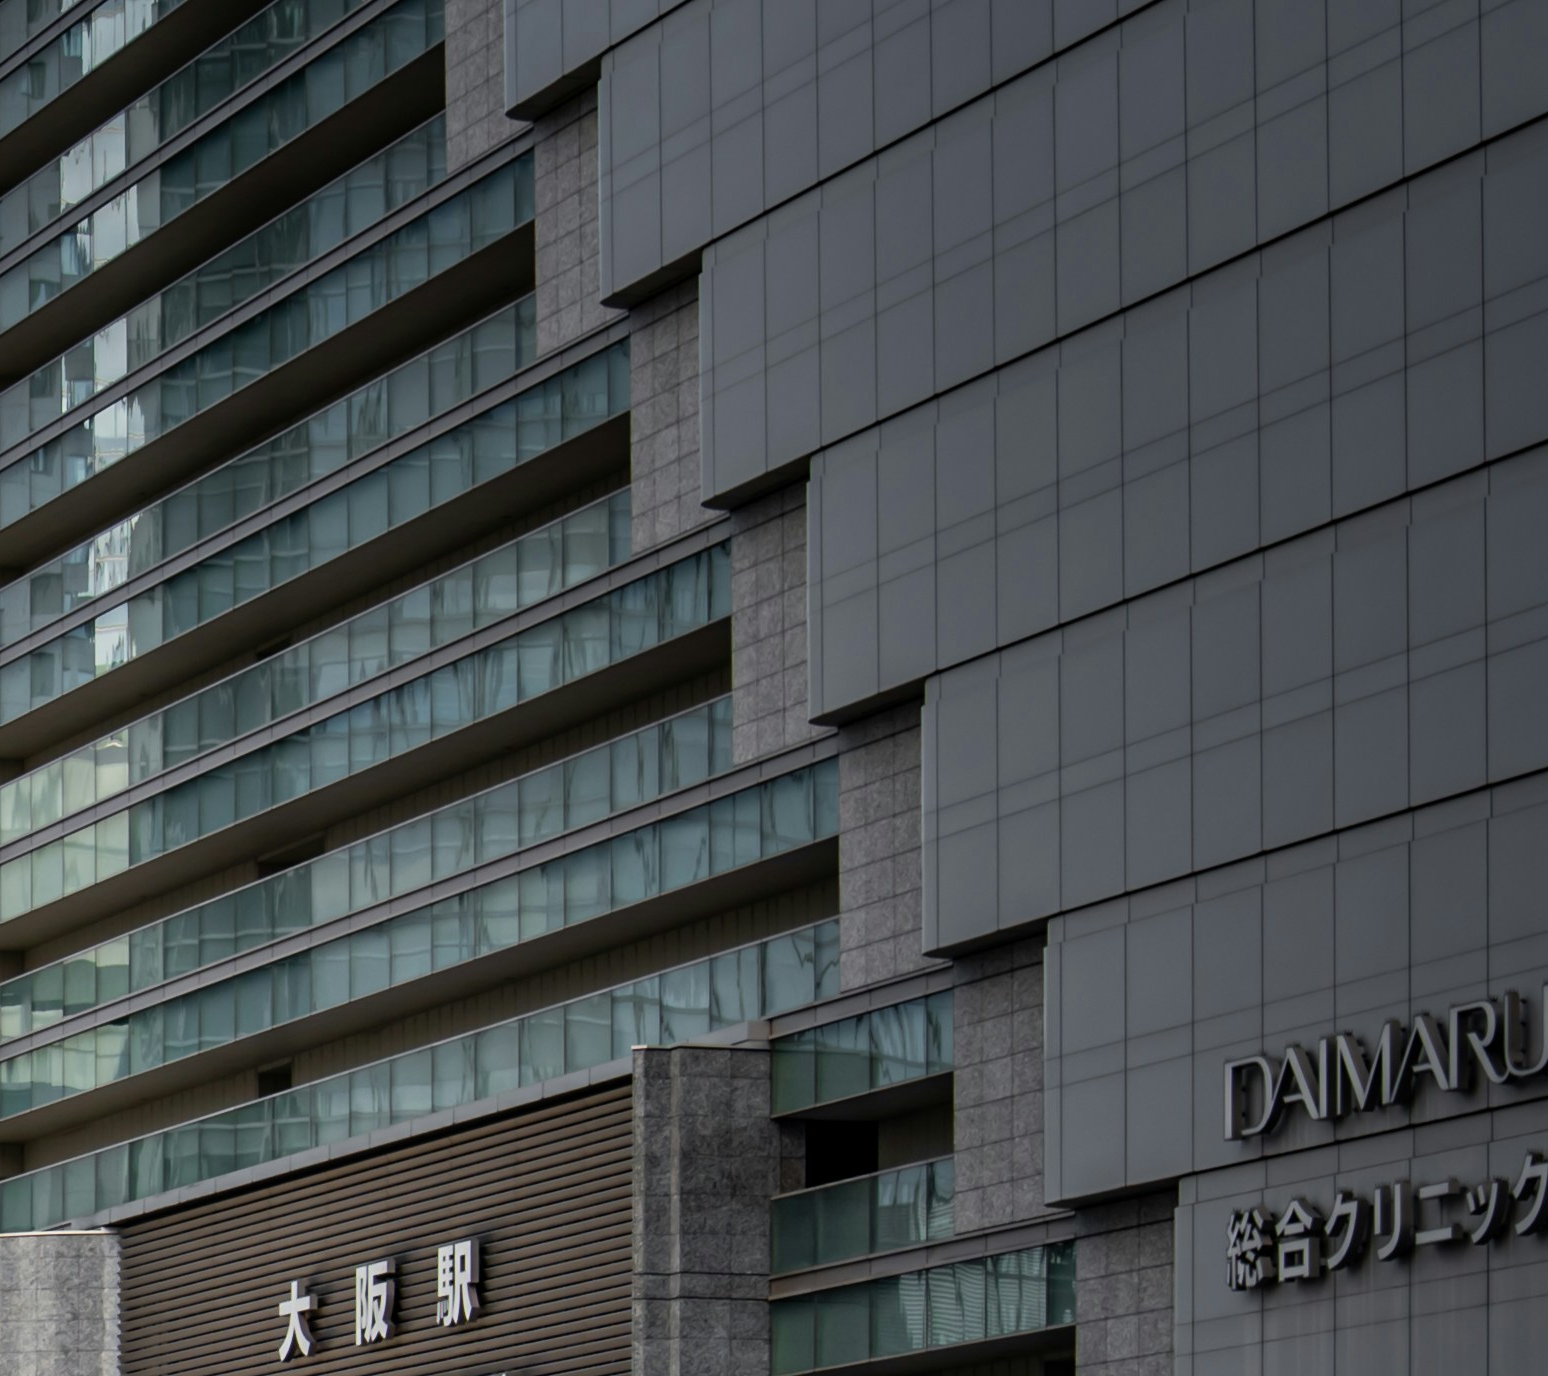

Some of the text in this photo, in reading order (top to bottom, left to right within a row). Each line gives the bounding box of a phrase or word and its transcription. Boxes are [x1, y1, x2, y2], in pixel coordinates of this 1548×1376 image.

[1224, 984, 1548, 1141] DAIMARU
[1227, 1152, 1548, 1291] 総合クリニック
[278, 1239, 480, 1362] 大阪駅
